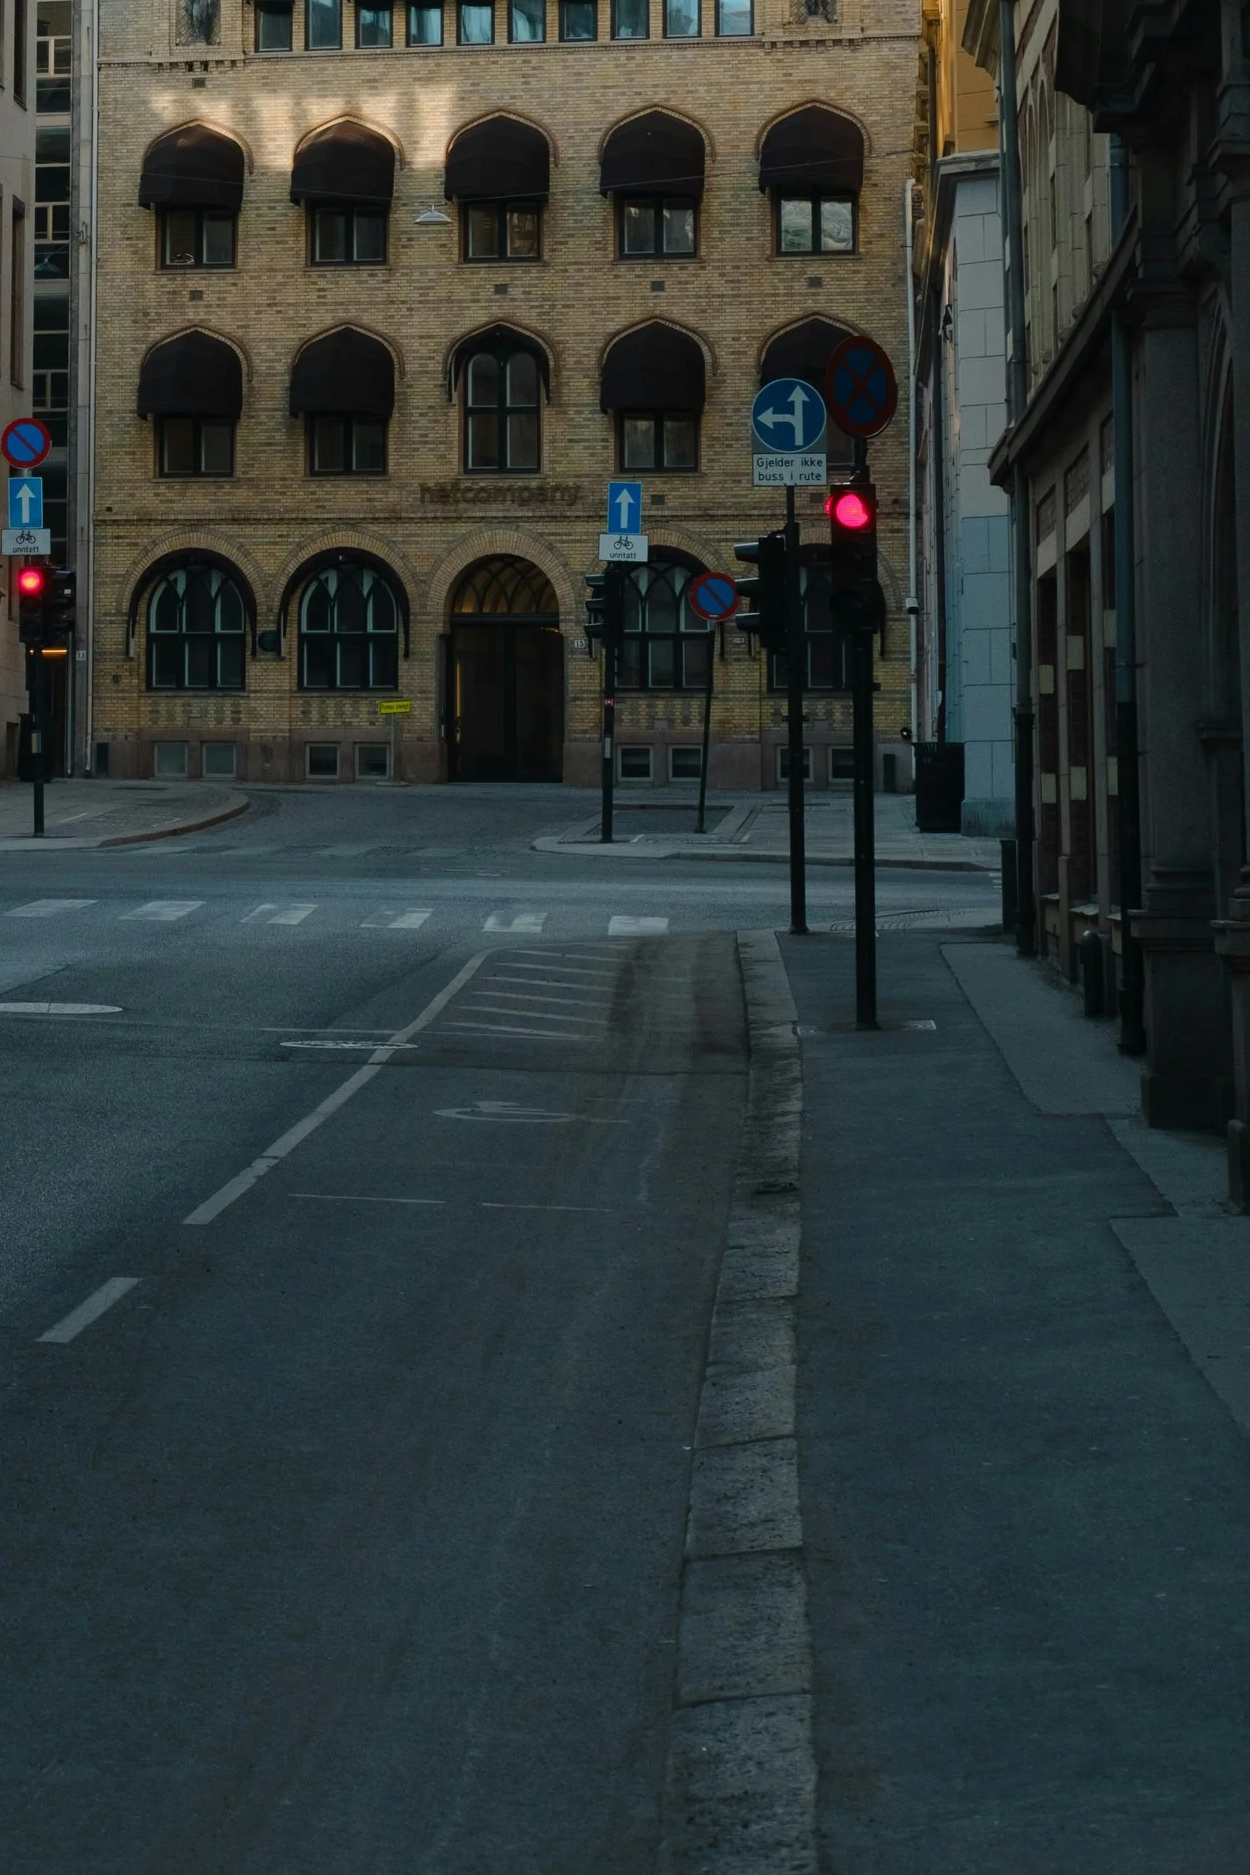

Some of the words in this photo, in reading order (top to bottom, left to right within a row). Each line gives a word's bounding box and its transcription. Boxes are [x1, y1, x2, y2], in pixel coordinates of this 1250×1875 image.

[756, 457, 795, 470] Gjelder
[801, 457, 823, 467] ikke
[758, 471, 784, 481] buss
[799, 472, 822, 481] rute
[420, 482, 580, 506] netcompany
